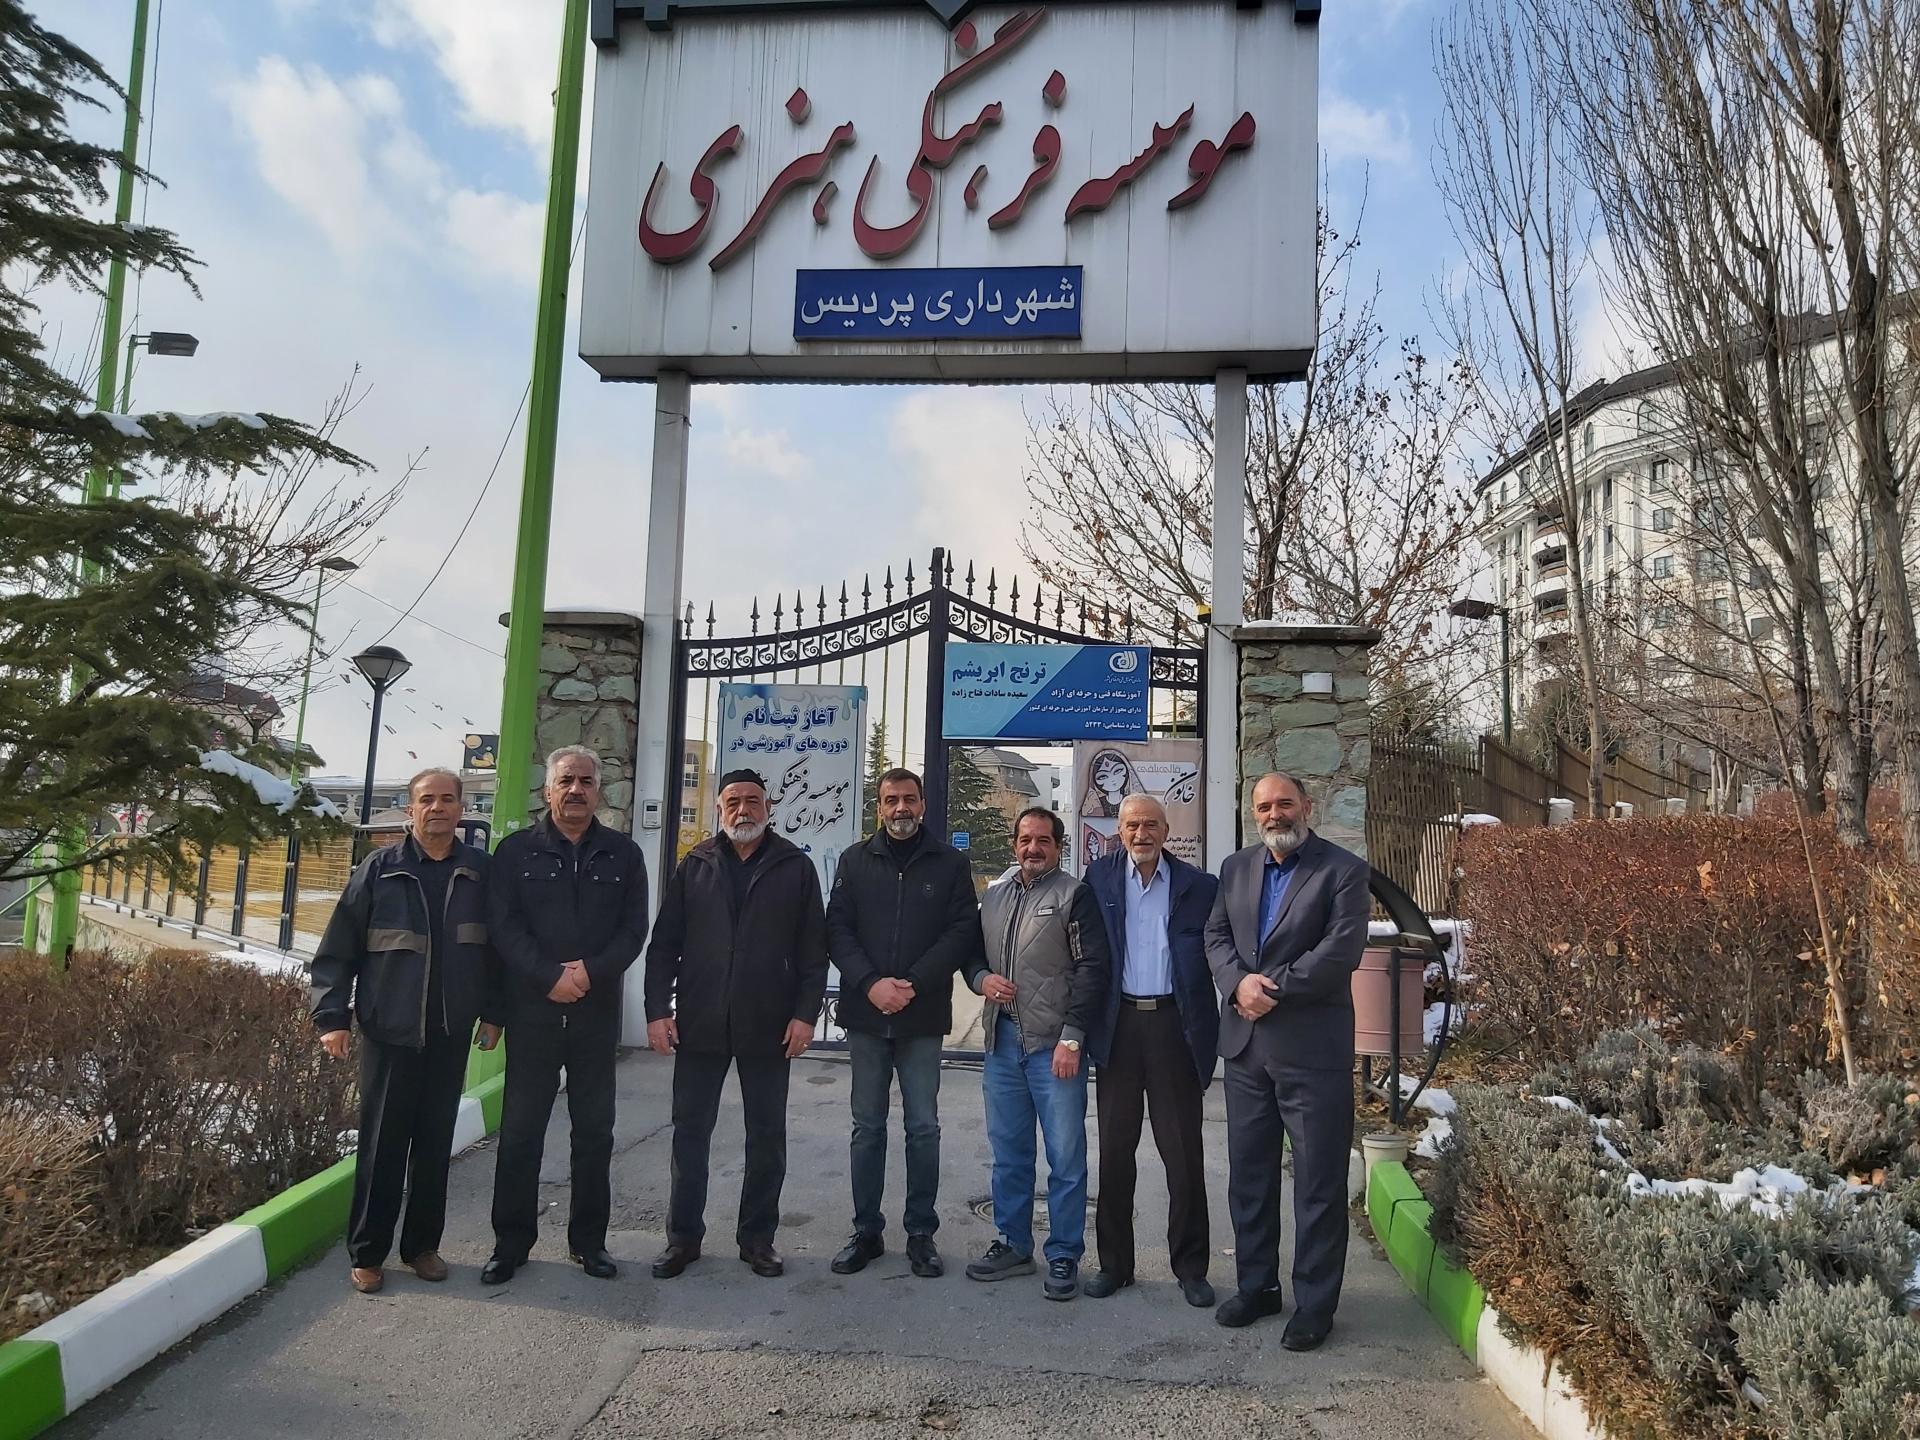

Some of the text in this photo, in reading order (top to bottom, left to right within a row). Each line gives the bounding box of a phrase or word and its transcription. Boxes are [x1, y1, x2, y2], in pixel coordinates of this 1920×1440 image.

[639, 5, 1255, 271] موسسه فرهنگی هنری
[801, 277, 1075, 328] شهرداری پردیس
[952, 660, 1047, 684] ترنج ابریشم
[951, 688, 1028, 699] سعیده سادات فتاح زاده
[1051, 688, 1065, 698] آزاد
[1066, 689, 1075, 698] ای
[1076, 689, 1092, 699] حرفه
[1098, 689, 1111, 699] فنی
[1112, 690, 1142, 700] آموزشگاه
[743, 704, 838, 731] آغاز ثبت نام
[1126, 721, 1142, 730] شماره
[730, 733, 849, 755] دوره های آموزشی در
[769, 754, 850, 805] موسسه فرهنگی
[785, 801, 845, 834] شهرداری
